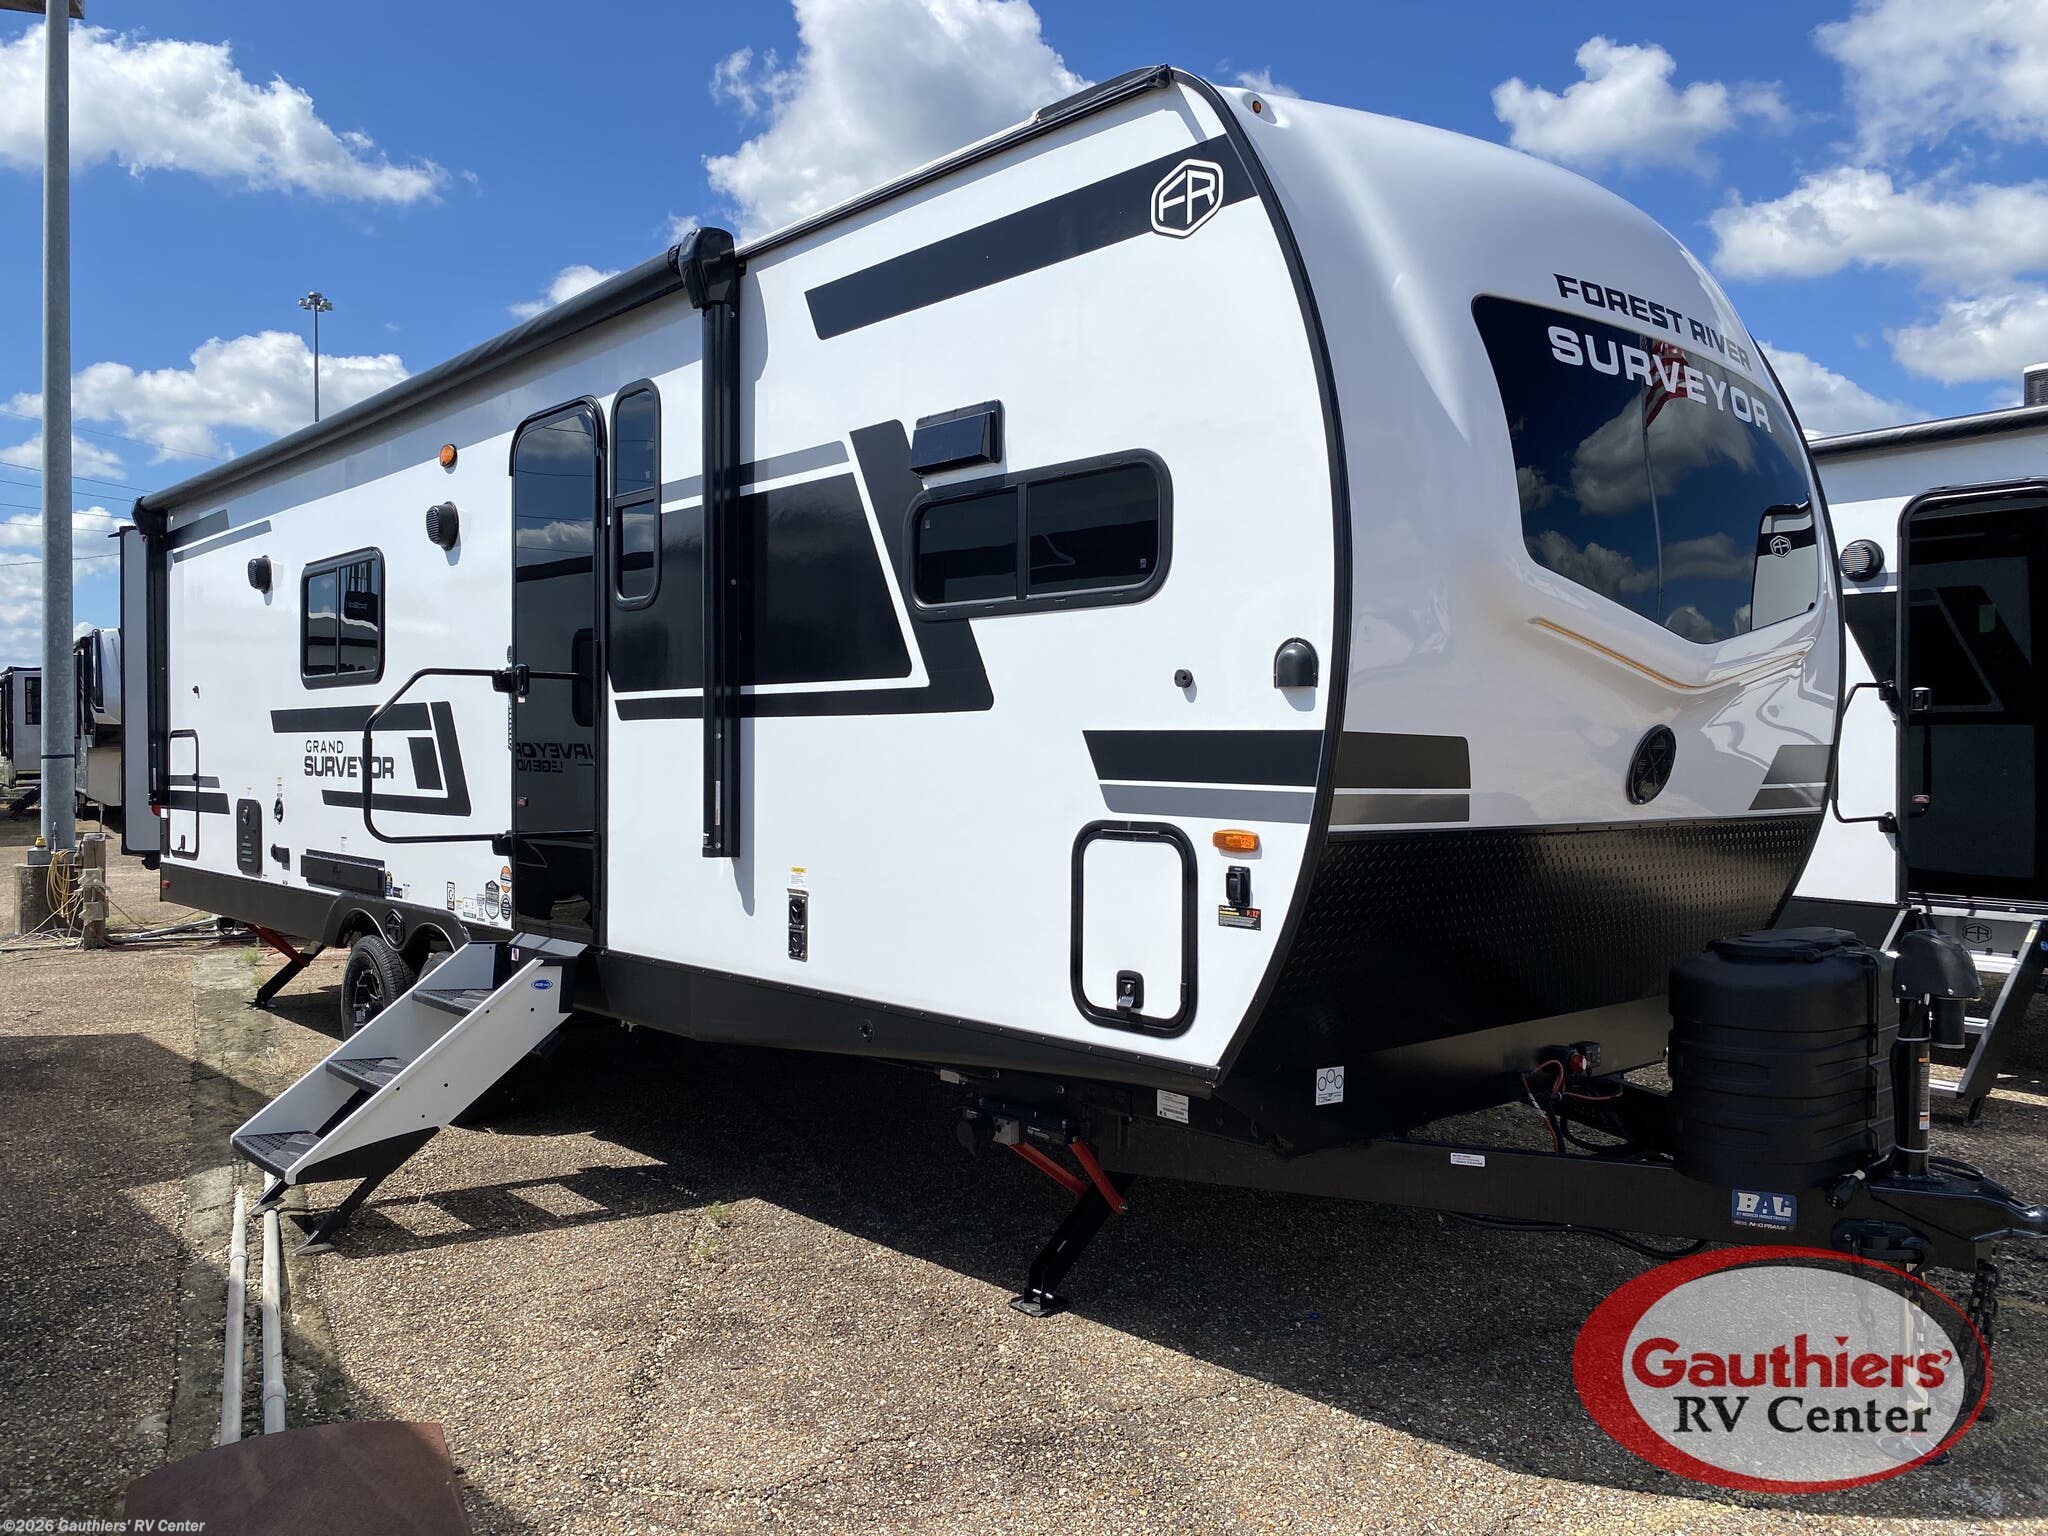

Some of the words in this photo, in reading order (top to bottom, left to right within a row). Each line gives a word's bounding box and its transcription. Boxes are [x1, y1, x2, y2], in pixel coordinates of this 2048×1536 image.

[1158, 169, 1216, 226] FR
[1552, 272, 1683, 334] FOREST
[1687, 316, 1752, 372] RIVER
[1547, 325, 1772, 434] SURVEYOR
[305, 739, 344, 754] GRAND
[1736, 1192, 1792, 1217] BAL
